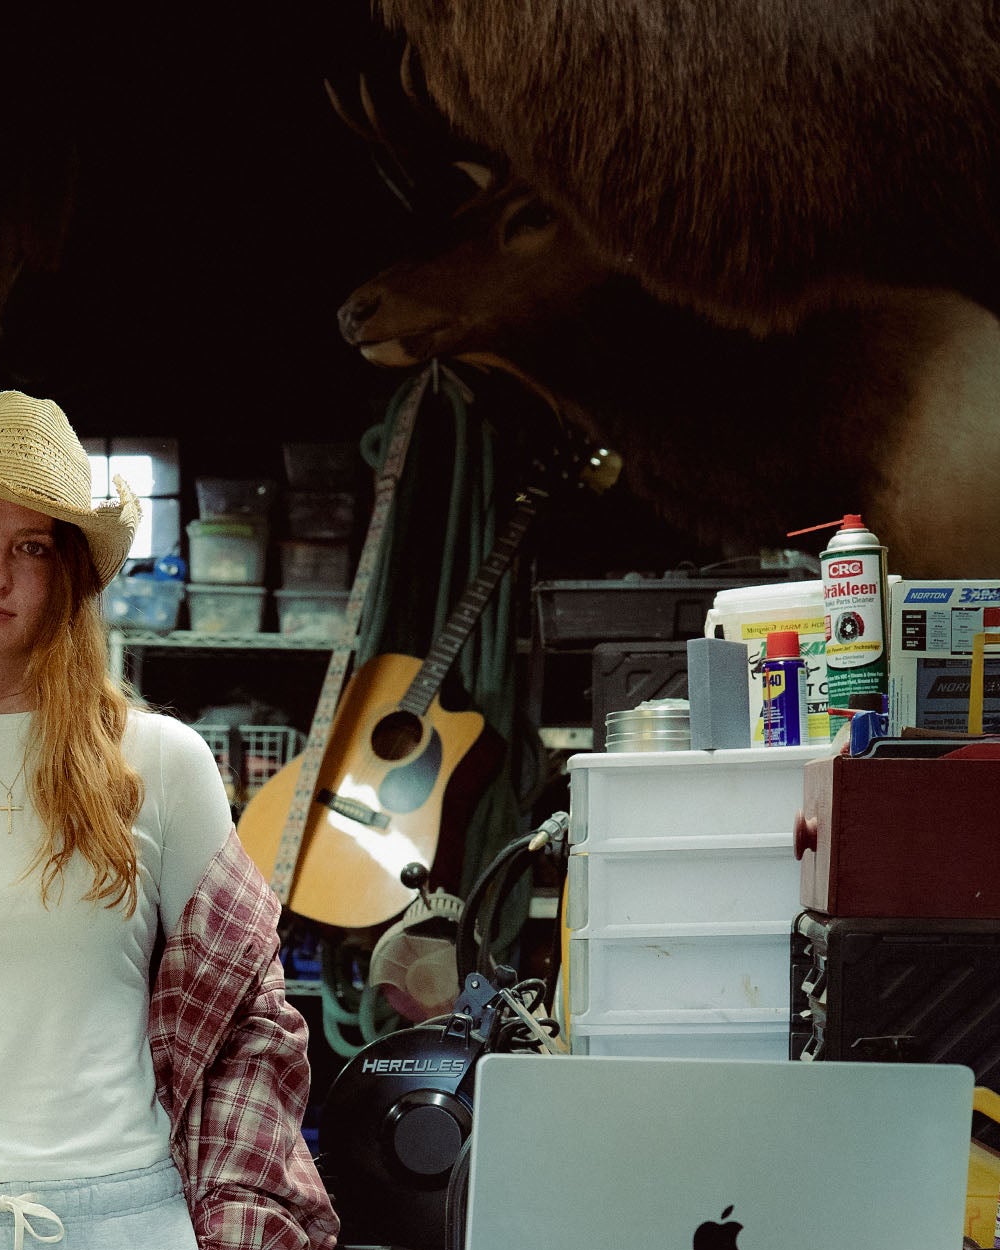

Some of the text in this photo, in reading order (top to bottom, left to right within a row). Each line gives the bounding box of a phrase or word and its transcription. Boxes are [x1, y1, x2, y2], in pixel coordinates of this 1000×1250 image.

[829, 562, 861, 576] CRC
[851, 596, 875, 604] Cleaner
[910, 592, 948, 600] NORTON
[853, 643, 880, 651] Technology
[936, 682, 970, 693] NORT
[361, 1059, 466, 1073] HERCULES
